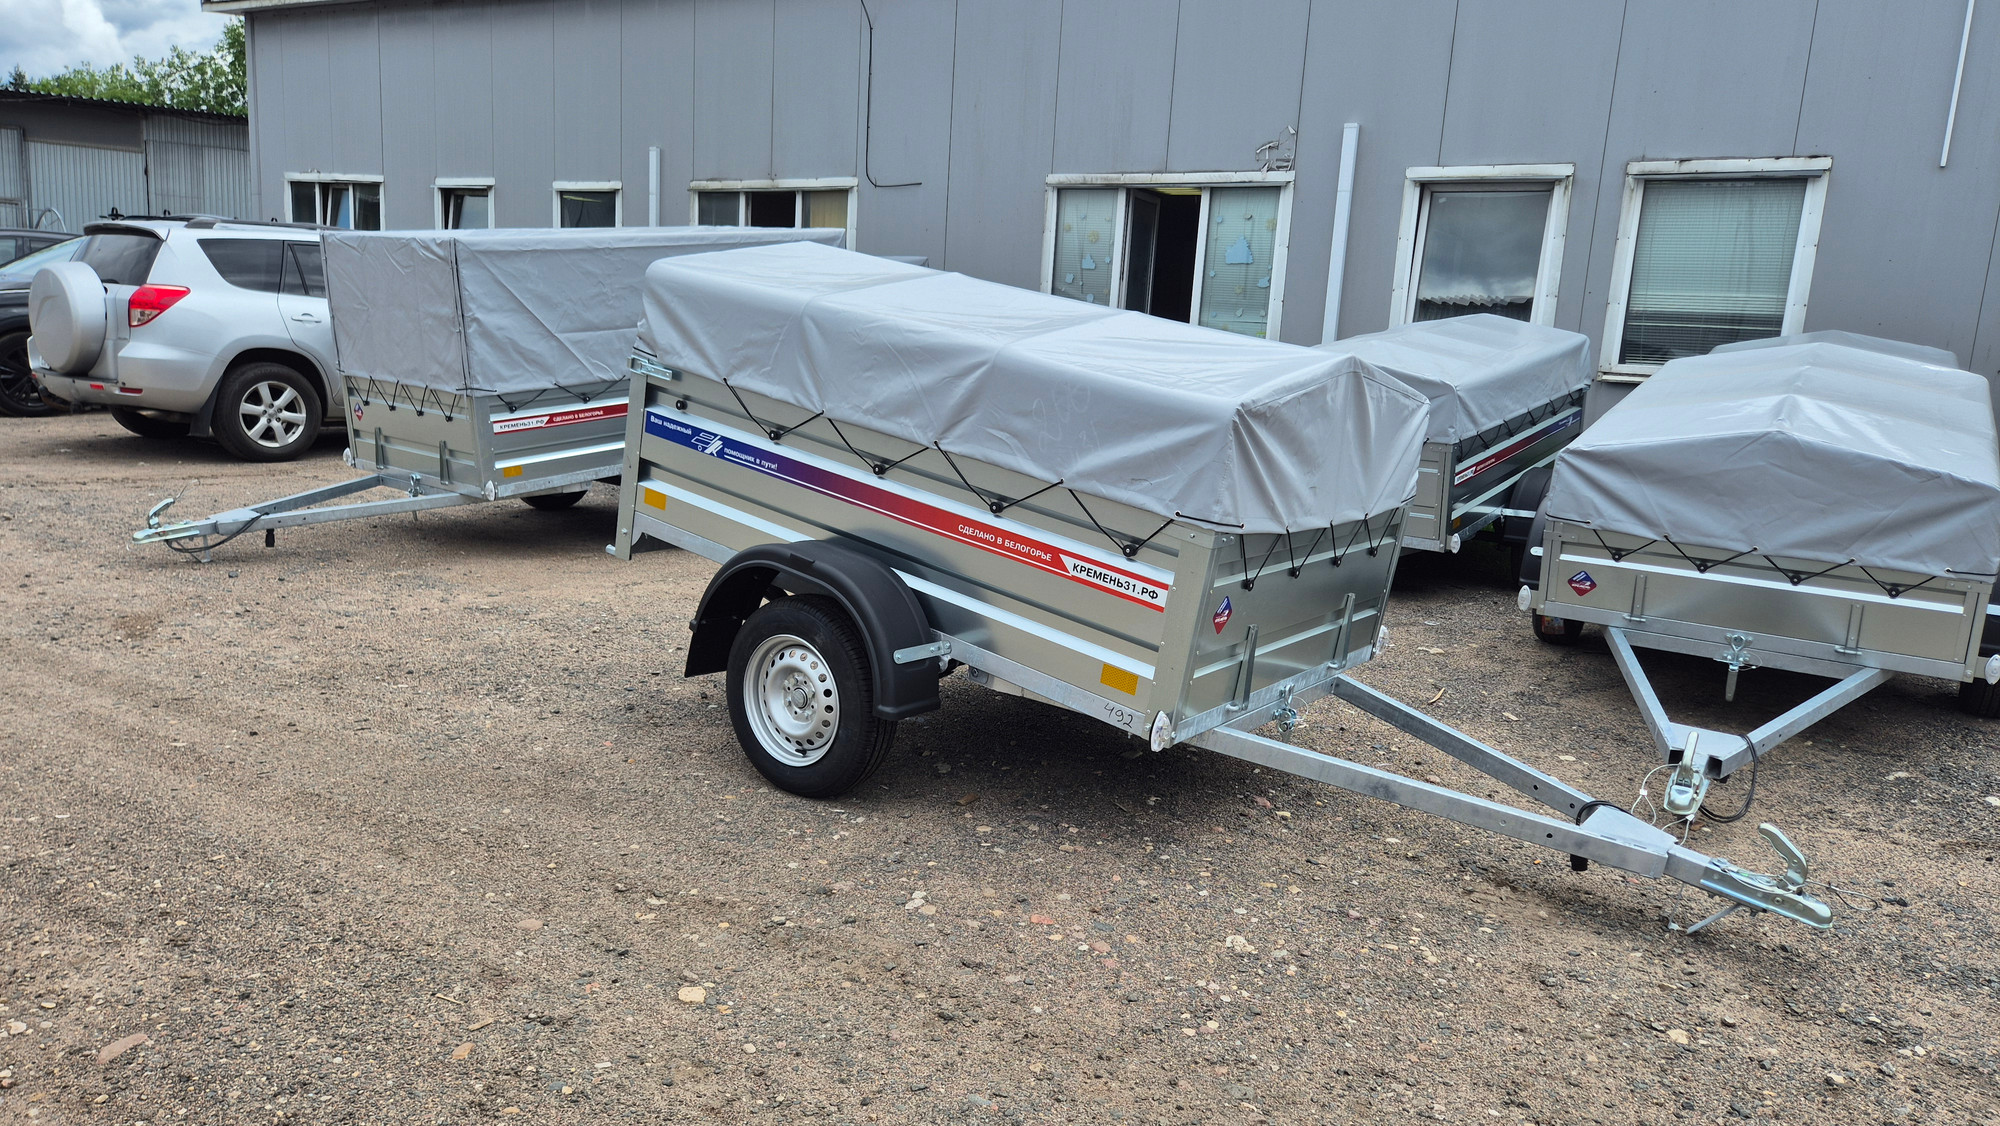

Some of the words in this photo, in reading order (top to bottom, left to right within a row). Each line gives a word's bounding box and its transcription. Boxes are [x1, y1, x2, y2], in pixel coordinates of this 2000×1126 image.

[499, 419, 545, 430] КРЕМЕНЬ31.РФ
[650, 415, 663, 425] Ваш
[723, 447, 755, 462] помощник
[761, 460, 778, 471] пути!
[958, 524, 995, 542] СДЕЛАНО
[996, 536, 1003, 545] В
[1004, 539, 1053, 562] БЕЛОГОРЬЕ
[1072, 562, 1159, 600] КРЕМЕНЬ31.РФ
[1103, 702, 1133, 729] 492
